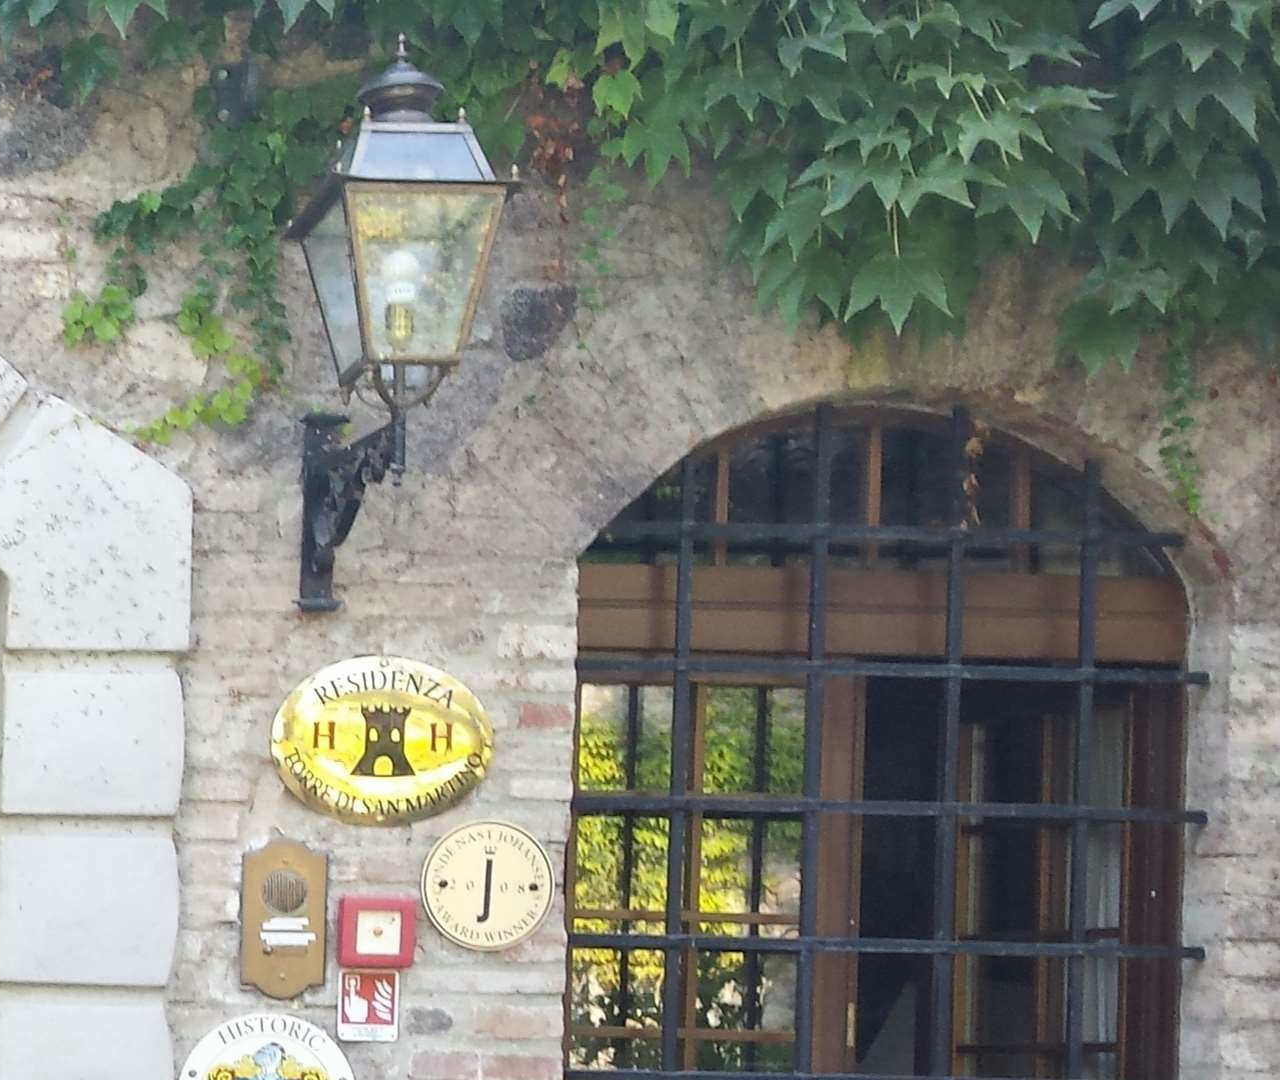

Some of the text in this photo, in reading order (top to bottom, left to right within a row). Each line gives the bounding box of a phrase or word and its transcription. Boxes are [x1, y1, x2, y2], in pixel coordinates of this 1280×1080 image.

[314, 670, 454, 708] RESIDENZA
[313, 720, 336, 750] H
[430, 722, 453, 752] H
[284, 747, 483, 816] TORRE DI SAN MARTINO
[435, 904, 537, 943] AWARD WINNER
[218, 1017, 326, 1051] HISTORIC
